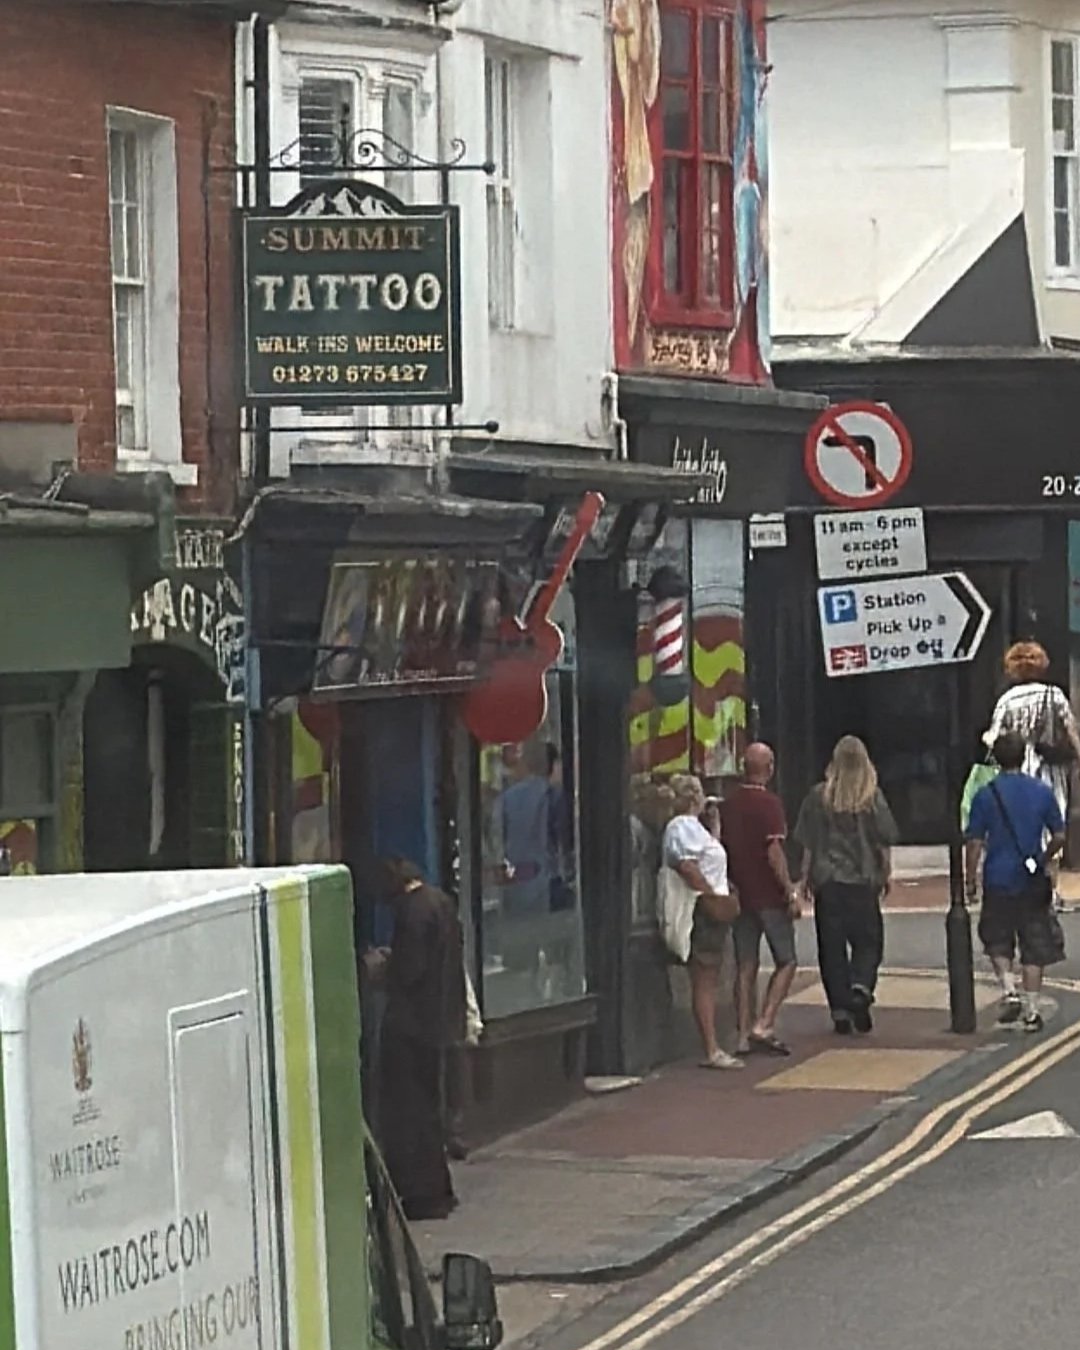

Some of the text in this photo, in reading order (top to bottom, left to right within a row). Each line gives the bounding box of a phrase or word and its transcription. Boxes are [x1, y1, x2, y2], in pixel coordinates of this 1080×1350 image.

[268, 226, 425, 251] SUMMIT
[255, 273, 442, 312] TATTOO
[356, 334, 445, 353] WELCOME
[272, 364, 428, 383] 01273 675427
[843, 536, 899, 553] except
[846, 556, 899, 572] cycles
[831, 595, 851, 621] P
[864, 591, 926, 610] Station
[867, 620, 902, 636] Pick
[909, 617, 932, 634] Up
[870, 645, 910, 661] Drop
[50, 1135, 120, 1183] WAITROSE
[58, 1211, 210, 1312] WAITROSE.COM
[223, 1274, 259, 1336] OUR
